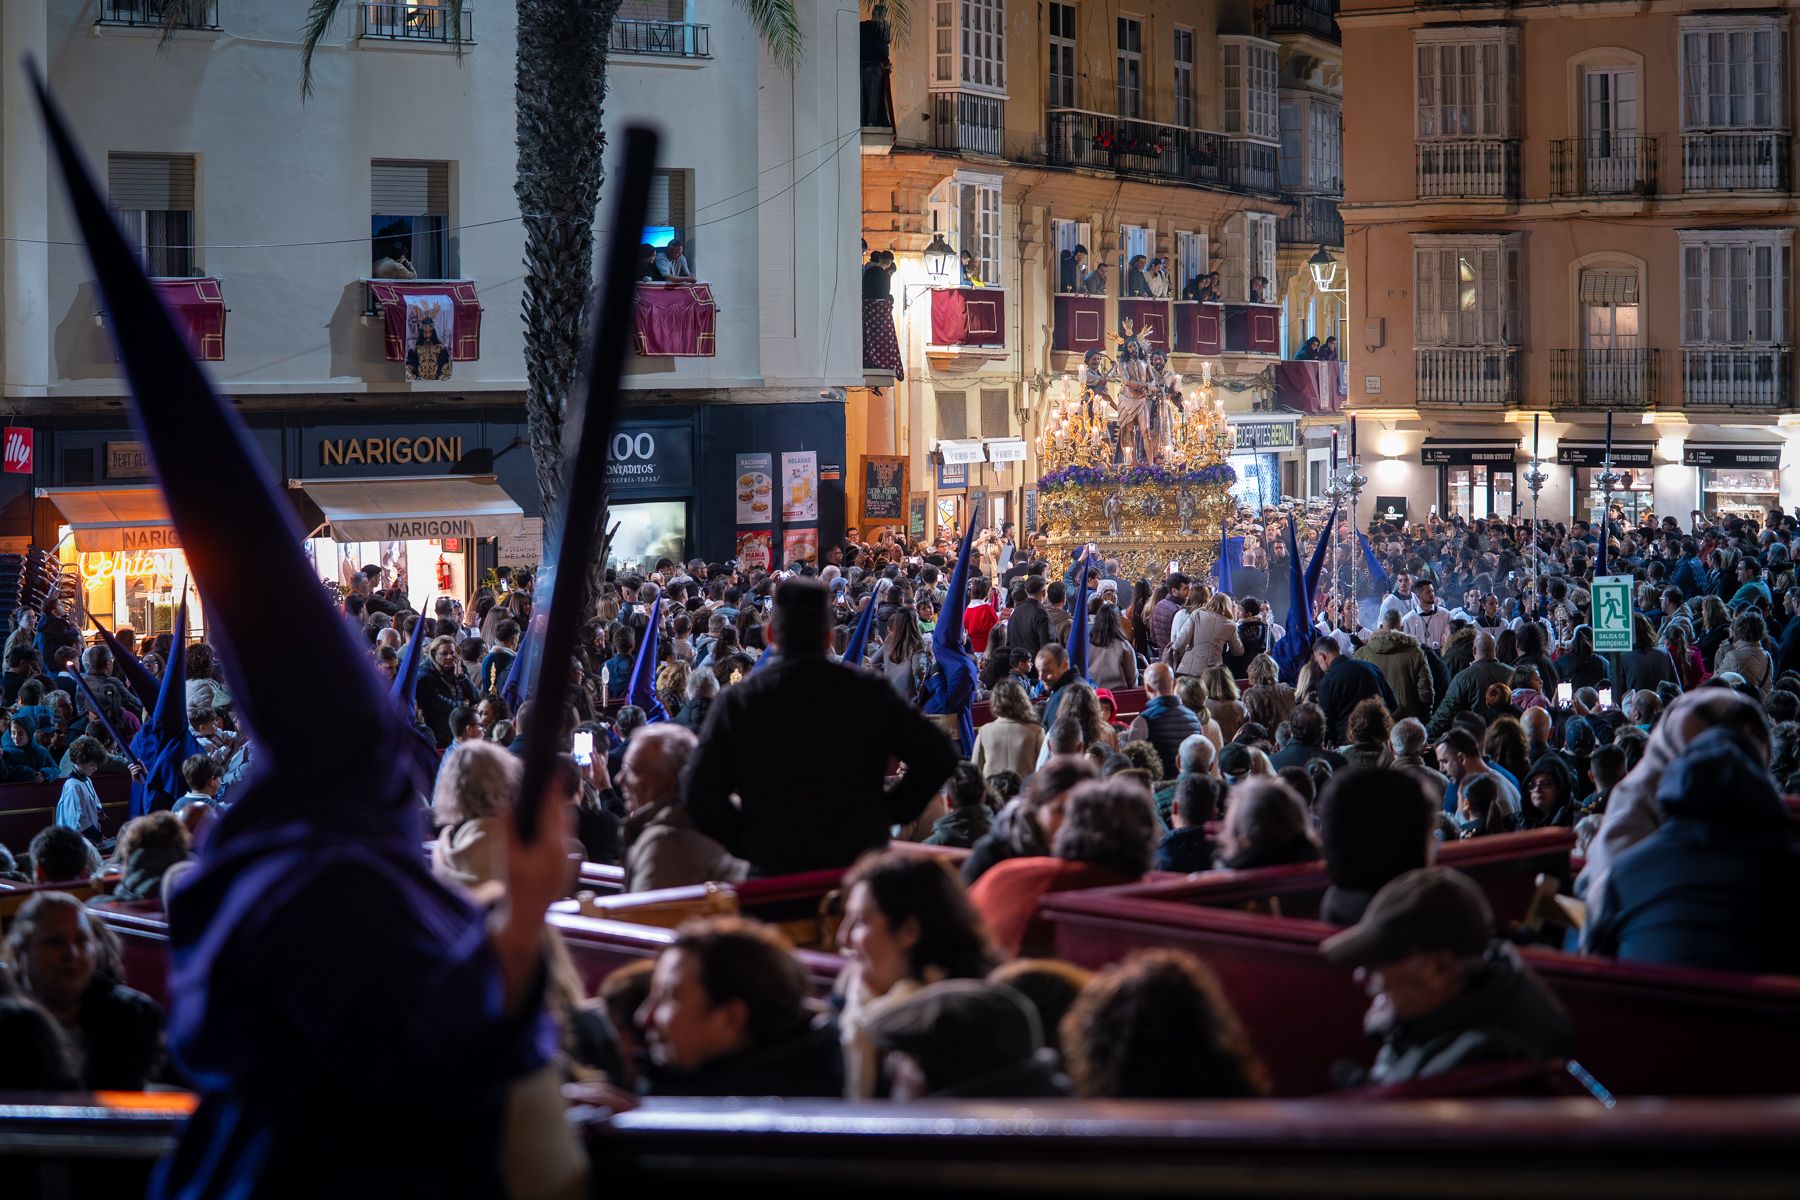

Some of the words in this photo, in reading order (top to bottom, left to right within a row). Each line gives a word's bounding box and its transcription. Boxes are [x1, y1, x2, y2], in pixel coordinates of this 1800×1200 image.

[1271, 423, 1293, 445] BERNAL
[5, 433, 30, 469] illy
[322, 436, 462, 465] NARIGONI
[112, 453, 131, 467] BEST
[606, 463, 653, 475] ONTADITOS
[388, 519, 467, 538] NARIGONI
[125, 530, 181, 547] NARIG
[504, 552, 537, 560] HELADO
